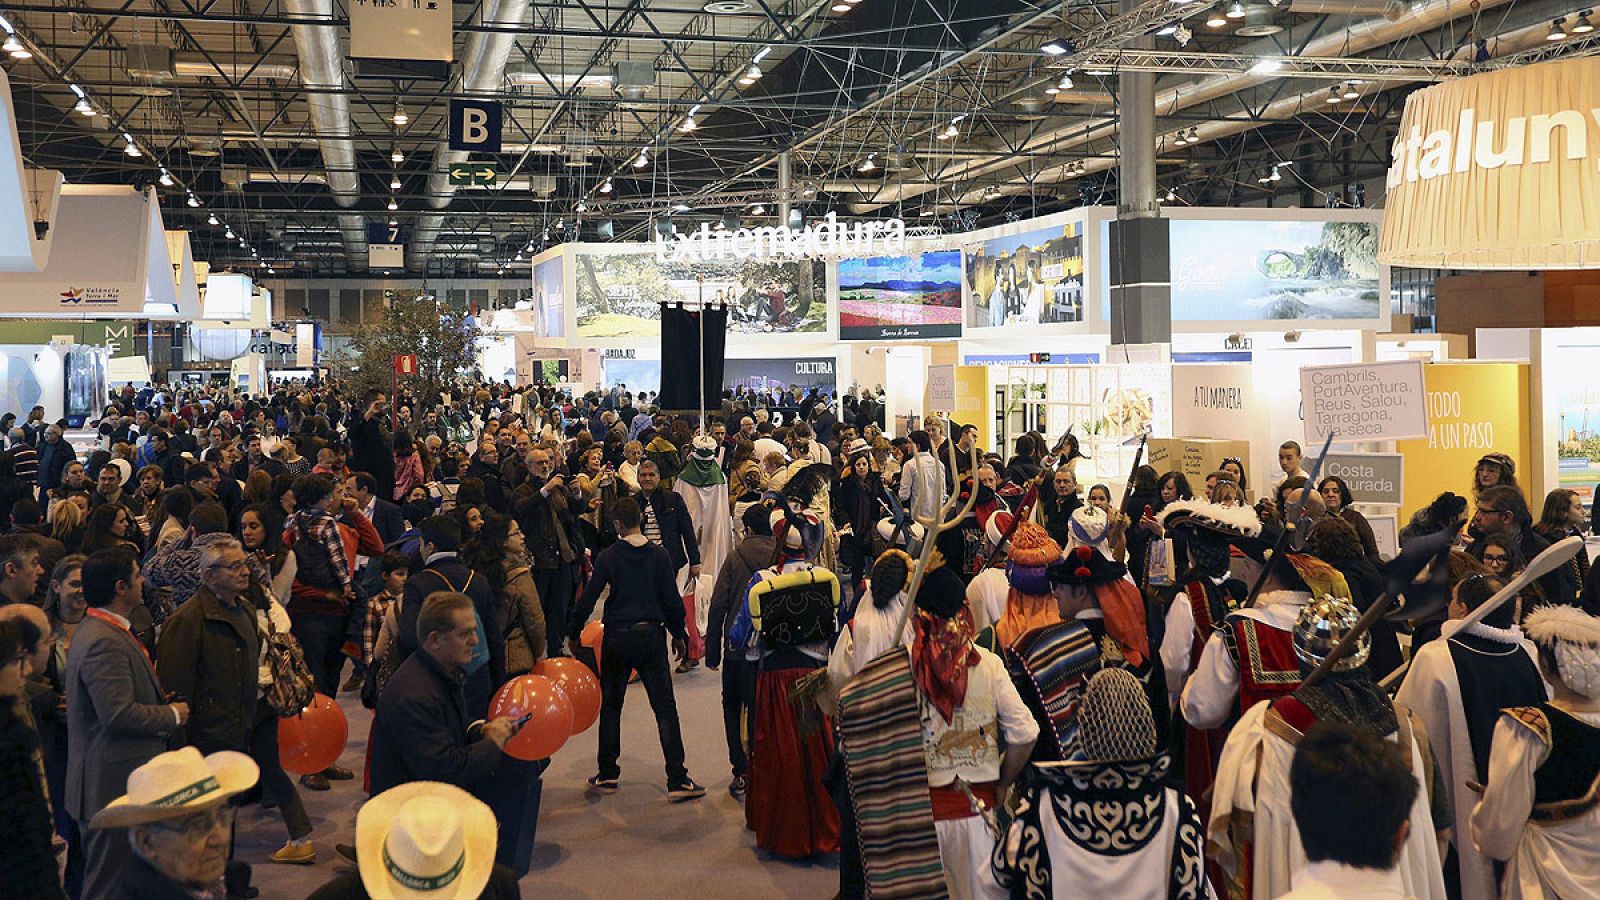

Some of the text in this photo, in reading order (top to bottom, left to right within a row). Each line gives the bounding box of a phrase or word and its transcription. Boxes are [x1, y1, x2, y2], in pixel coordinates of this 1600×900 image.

[463, 107, 489, 144] B
[1387, 107, 1600, 190] atalun
[388, 227, 399, 242] 7
[605, 348, 636, 359] BADAJOZ
[795, 361, 833, 374] CULTURA
[1311, 369, 1381, 385] Cambrils,
[1194, 385, 1242, 409] A TU MANERA
[1313, 381, 1413, 398] PortAventura,
[1314, 394, 1407, 412] Reus, Salou,
[1427, 391, 1461, 418] TODO
[1315, 410, 1393, 425] Tarragona,
[1315, 423, 1382, 438] Vila-seca
[1428, 421, 1494, 449] A UN PASO
[1328, 462, 1374, 478] Costa
